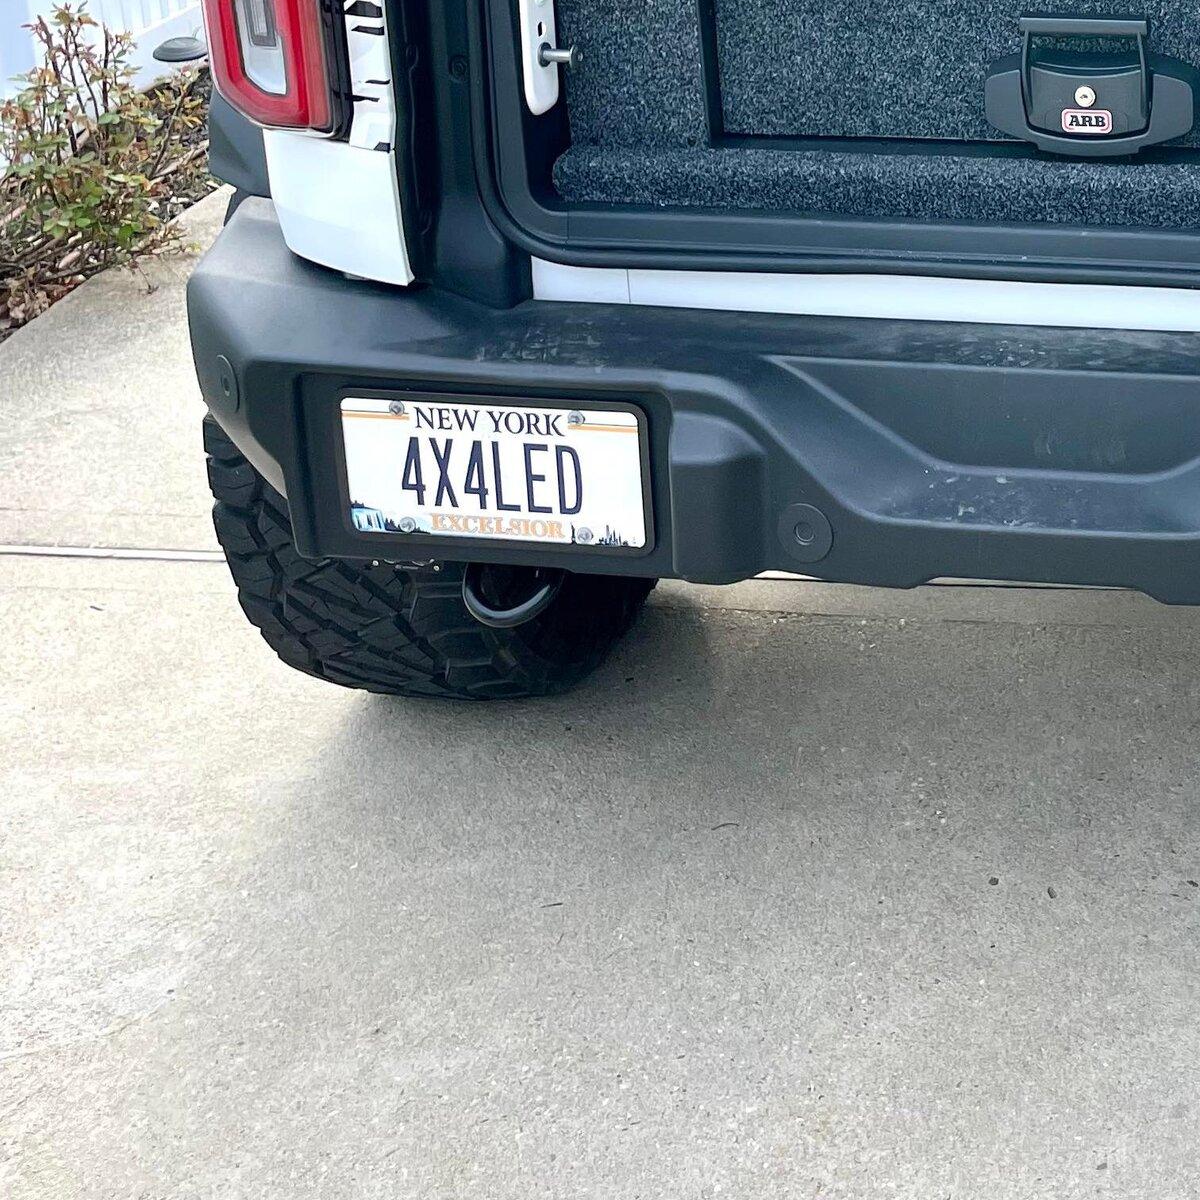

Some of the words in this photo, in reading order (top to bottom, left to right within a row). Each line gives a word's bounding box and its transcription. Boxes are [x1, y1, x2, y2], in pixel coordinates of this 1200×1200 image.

[1068, 114, 1106, 127] ARB
[413, 406, 480, 432] NEW
[486, 410, 566, 437] YORK
[401, 436, 584, 515] 4X4LED
[429, 512, 566, 539] EXCELSIOR
